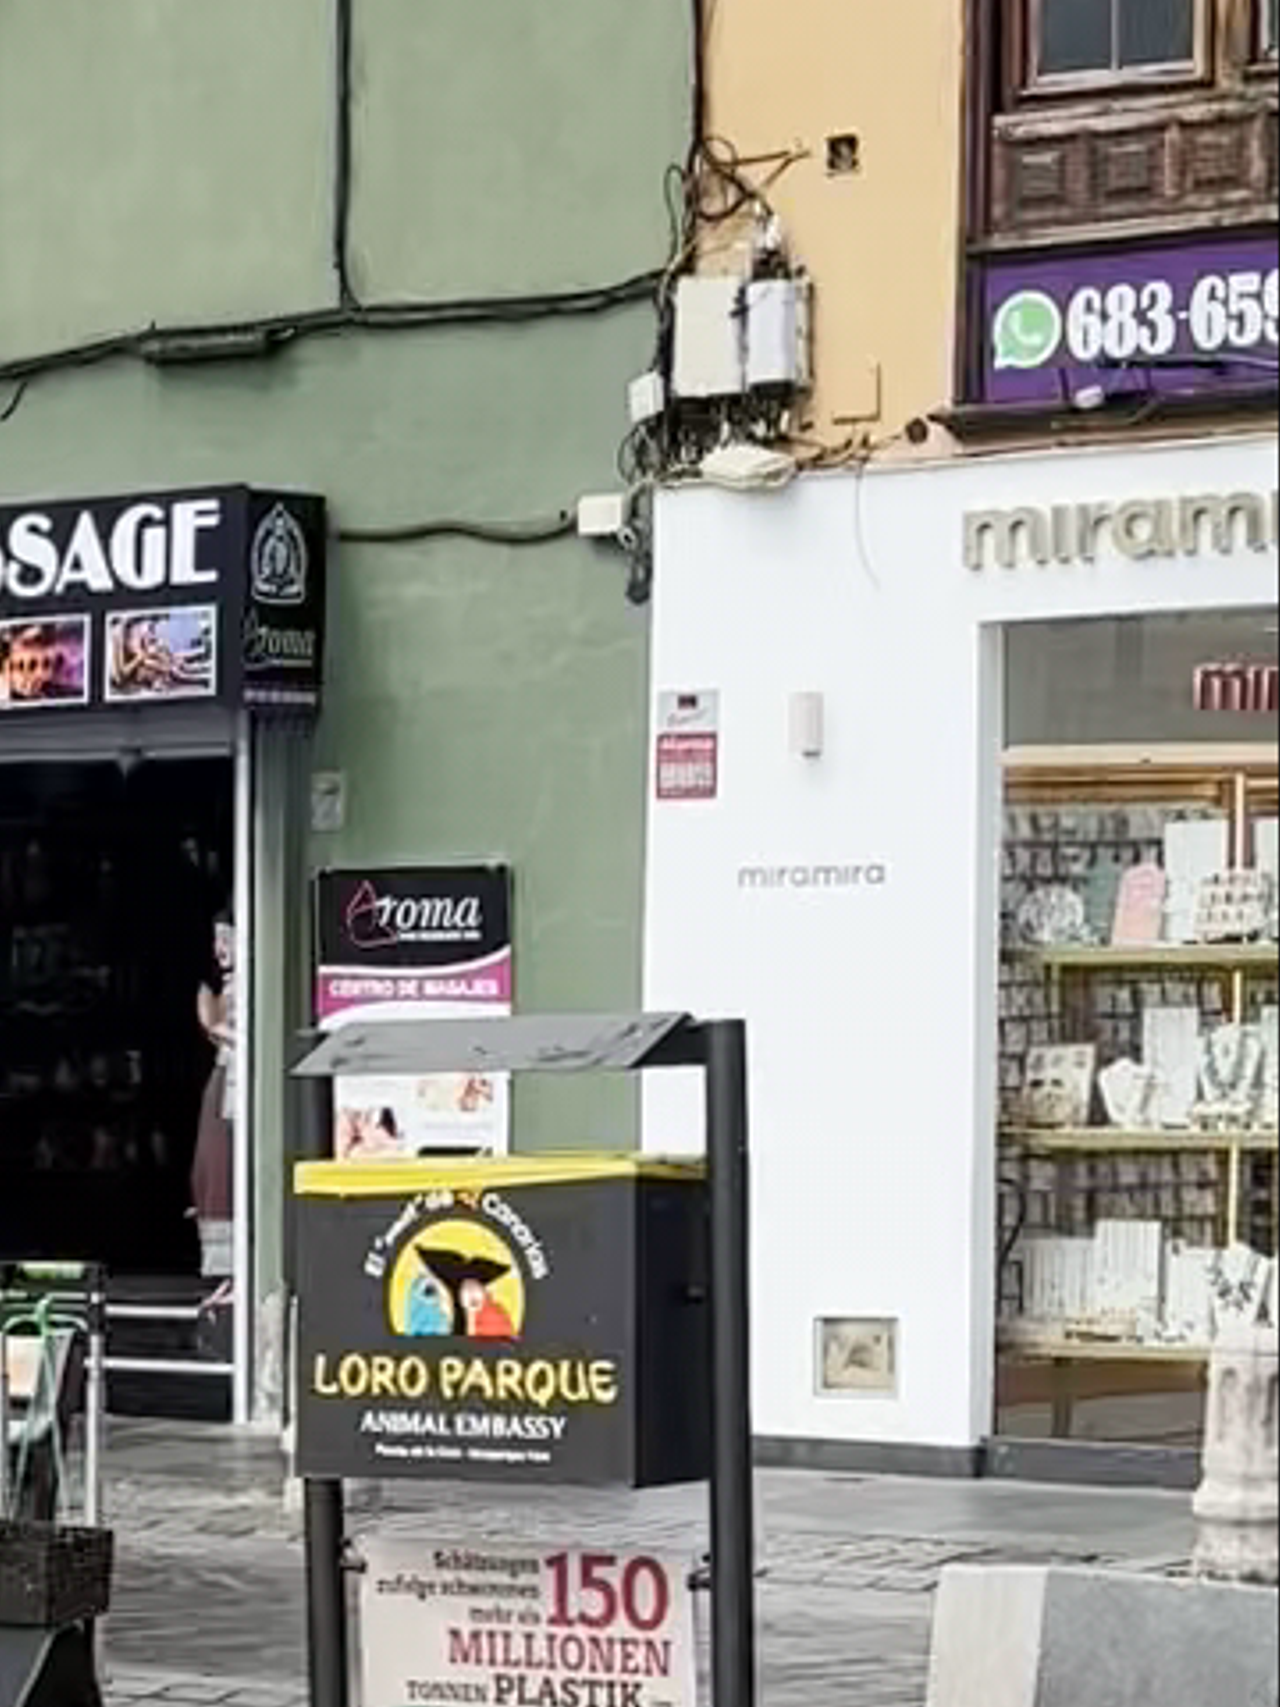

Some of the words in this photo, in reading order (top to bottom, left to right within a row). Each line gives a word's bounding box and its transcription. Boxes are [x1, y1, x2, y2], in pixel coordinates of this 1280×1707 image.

[738, 864, 887, 889] miramira
[346, 880, 482, 933] Aroma
[313, 1353, 428, 1398] LORO
[441, 1357, 618, 1407] PARQUE
[360, 1410, 452, 1436] ANIMAL
[455, 1413, 567, 1440] EMBASSY
[544, 1552, 669, 1631] 150
[448, 1629, 672, 1677] MILLIONEN
